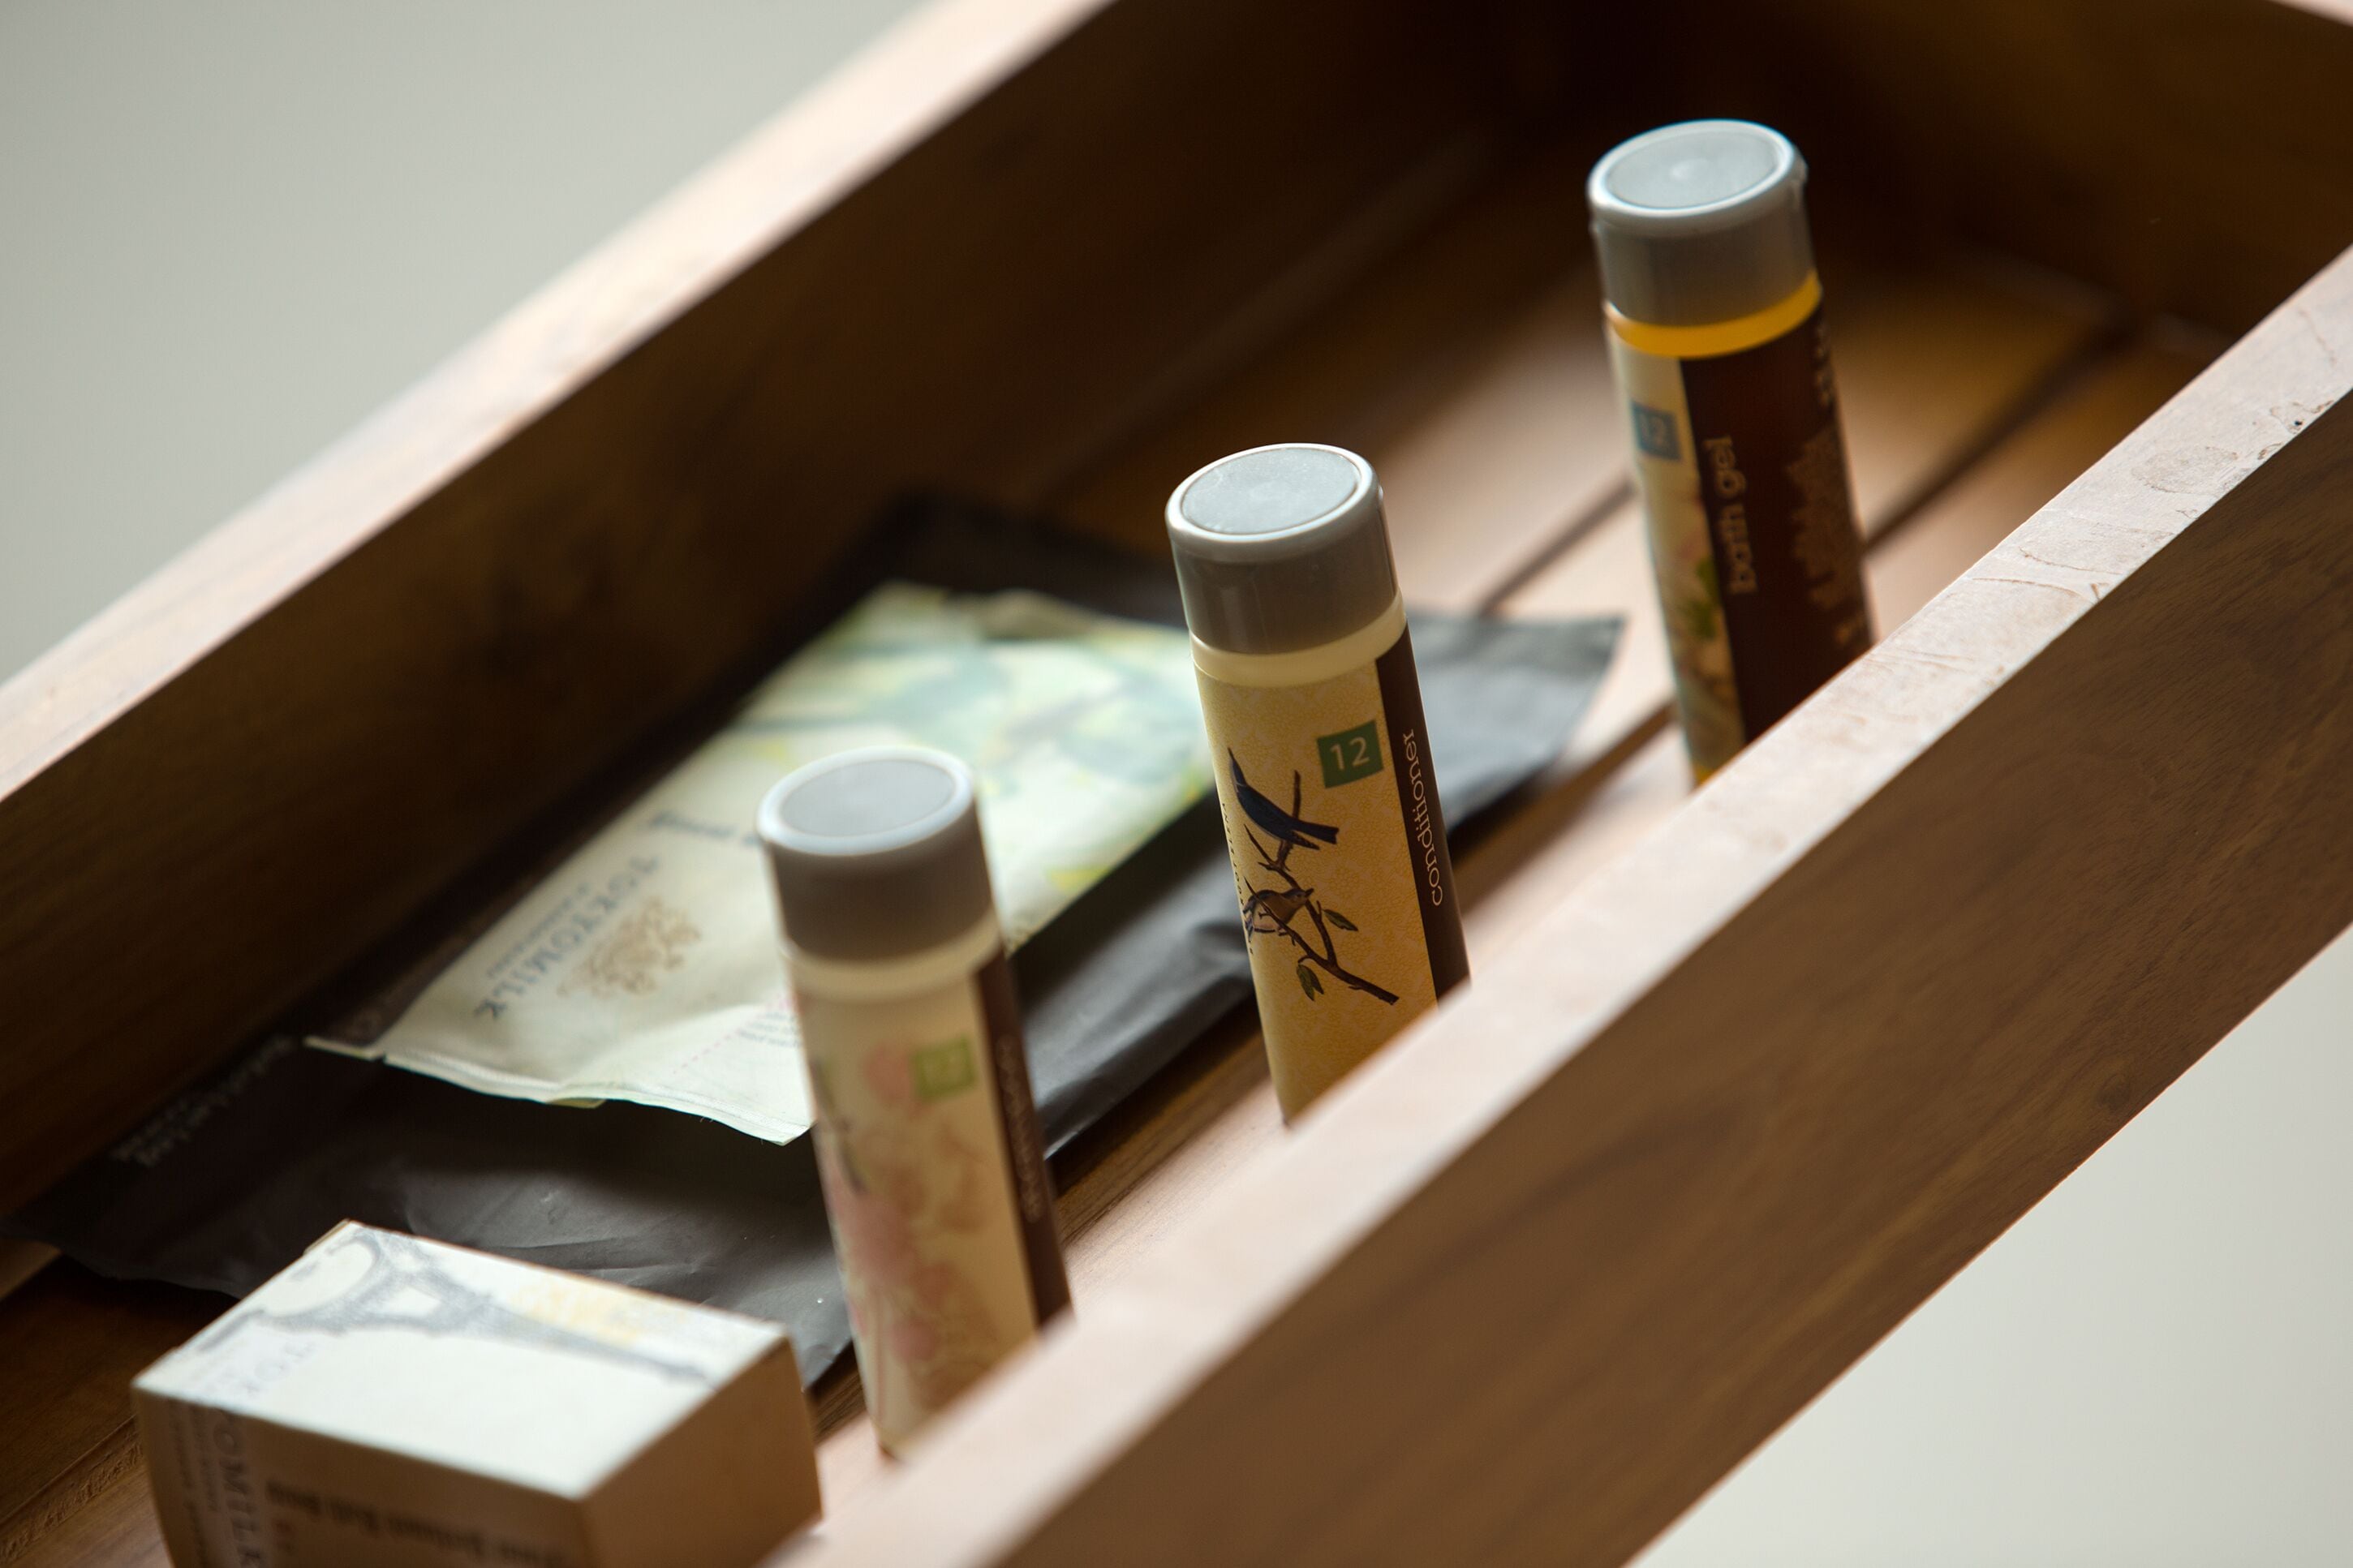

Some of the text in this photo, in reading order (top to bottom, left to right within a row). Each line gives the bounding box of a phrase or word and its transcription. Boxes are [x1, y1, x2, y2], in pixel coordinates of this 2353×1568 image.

[1703, 436, 1759, 594] bath gel
[1328, 737, 1370, 771] 12
[1402, 728, 1443, 906] conditioner
[474, 855, 661, 1017] TOKYOMILK
